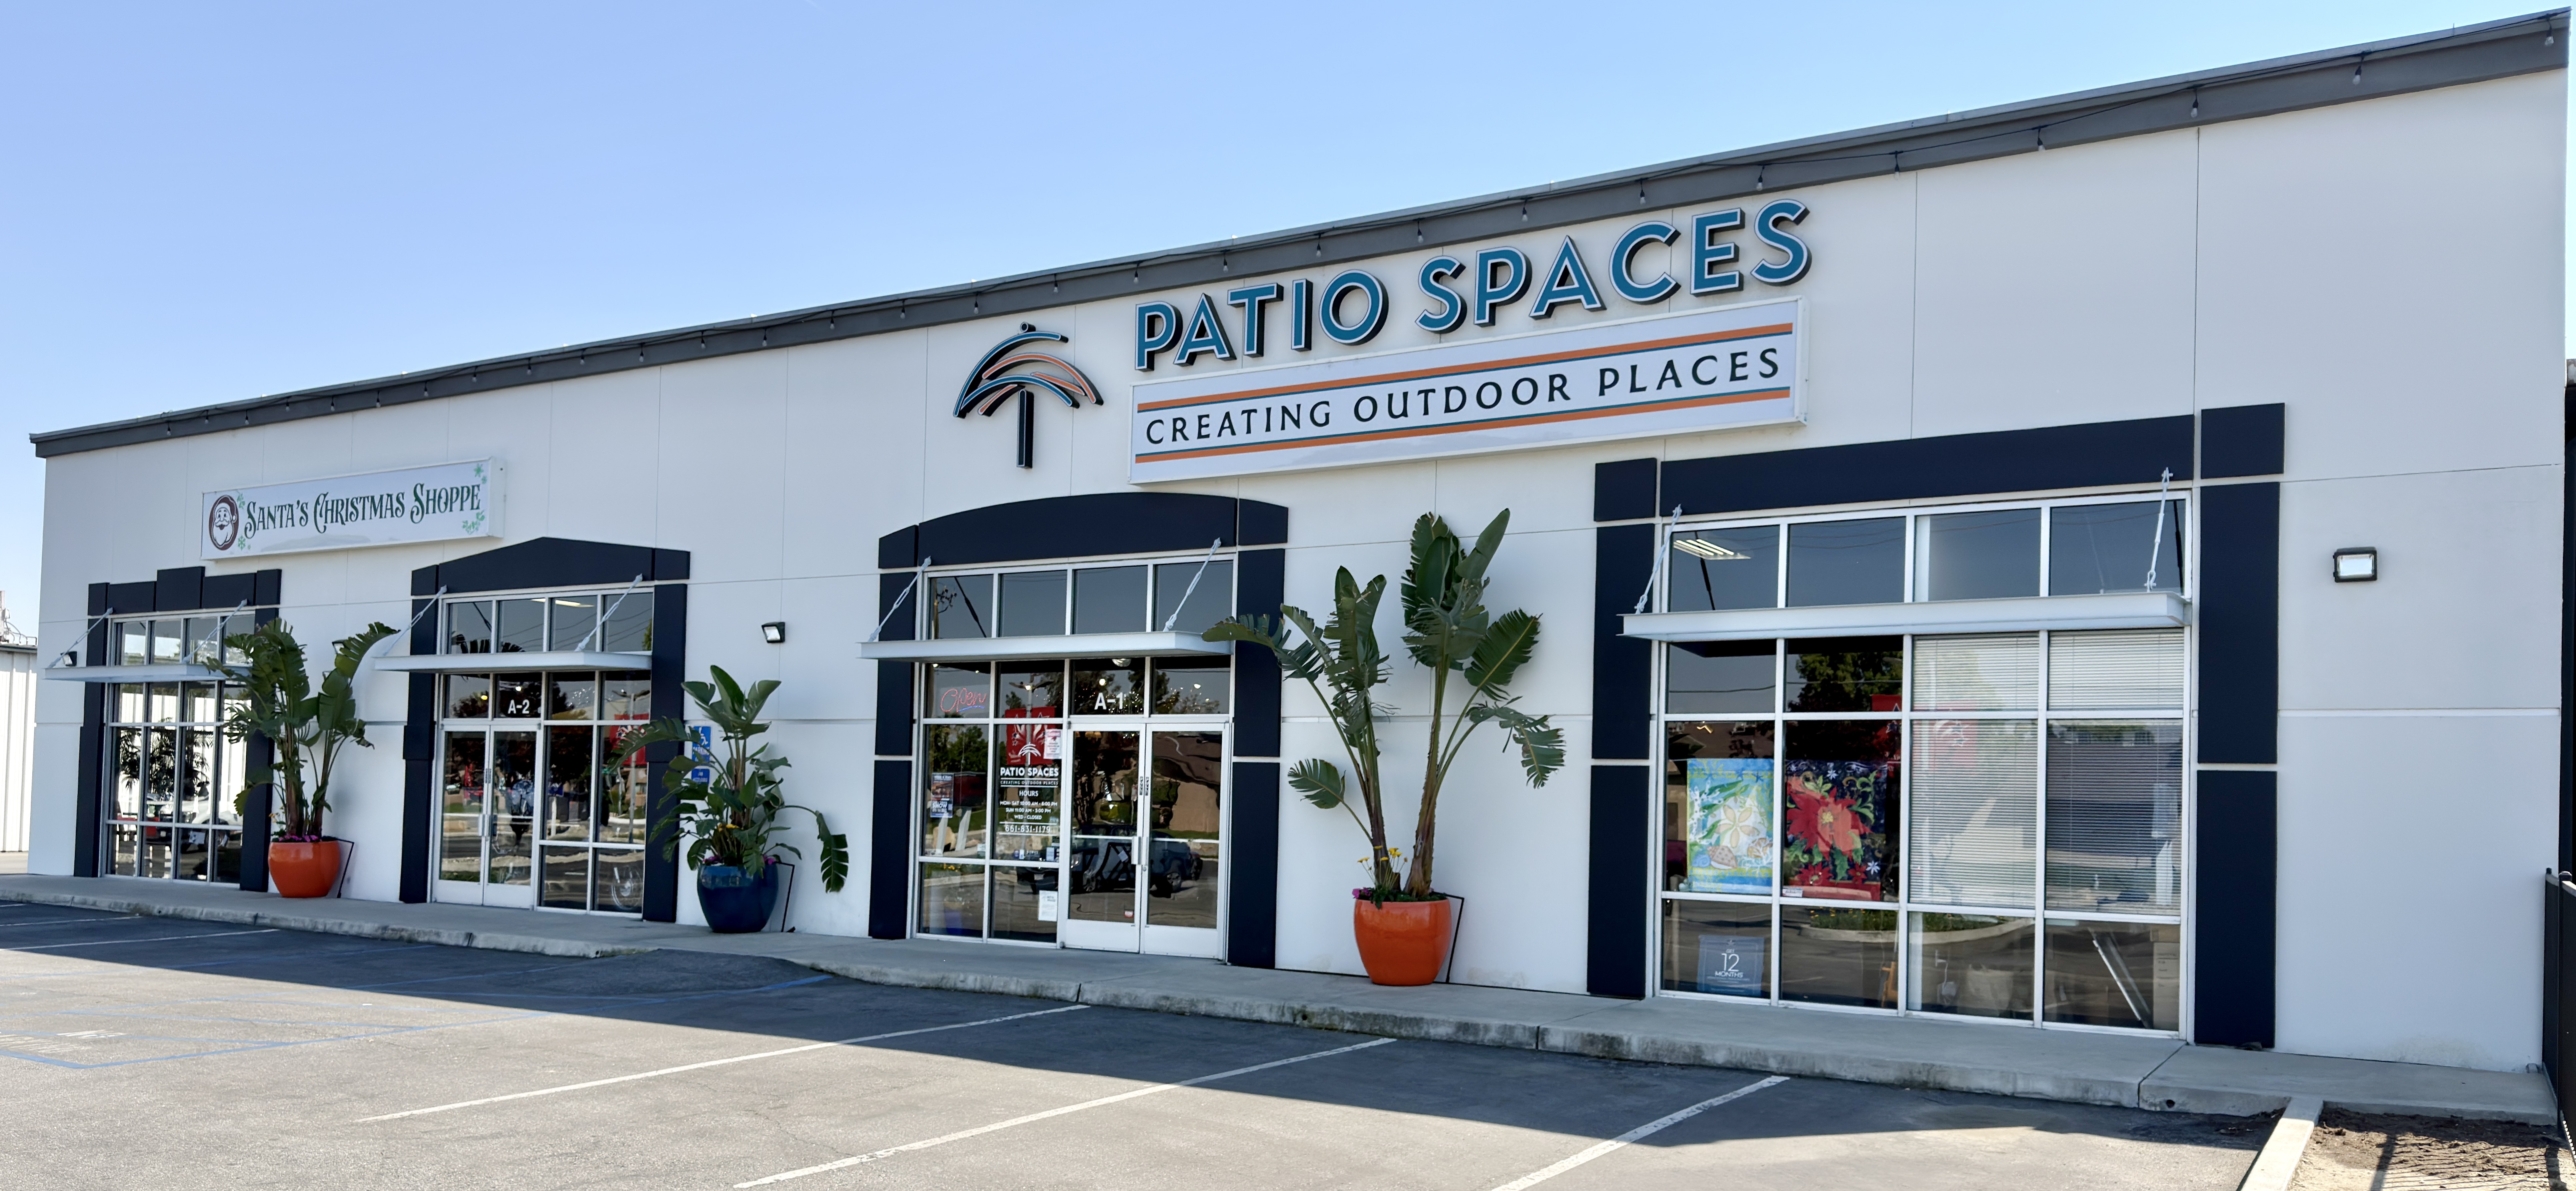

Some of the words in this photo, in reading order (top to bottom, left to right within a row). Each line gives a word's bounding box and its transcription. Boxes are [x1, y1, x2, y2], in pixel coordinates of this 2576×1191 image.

[1135, 269, 1388, 372] PATIO
[1415, 199, 1812, 333] SPACES
[1145, 400, 1331, 446] CREATING
[1353, 373, 1571, 423] OUTDOOR
[1598, 347, 1780, 396] PLACES
[244, 500, 309, 539] SANTA'S
[313, 491, 405, 534] CHRISTMAS
[410, 482, 481, 524] SHOPPE
[508, 699, 530, 714] A-2
[940, 688, 987, 713] Open
[1094, 692, 1123, 710] A-1
[1000, 767, 1025, 776] PATIO
[1027, 768, 1059, 777] SPACES
[1005, 825, 1051, 833] 661-831-1179
[1722, 953, 1739, 972] 12
